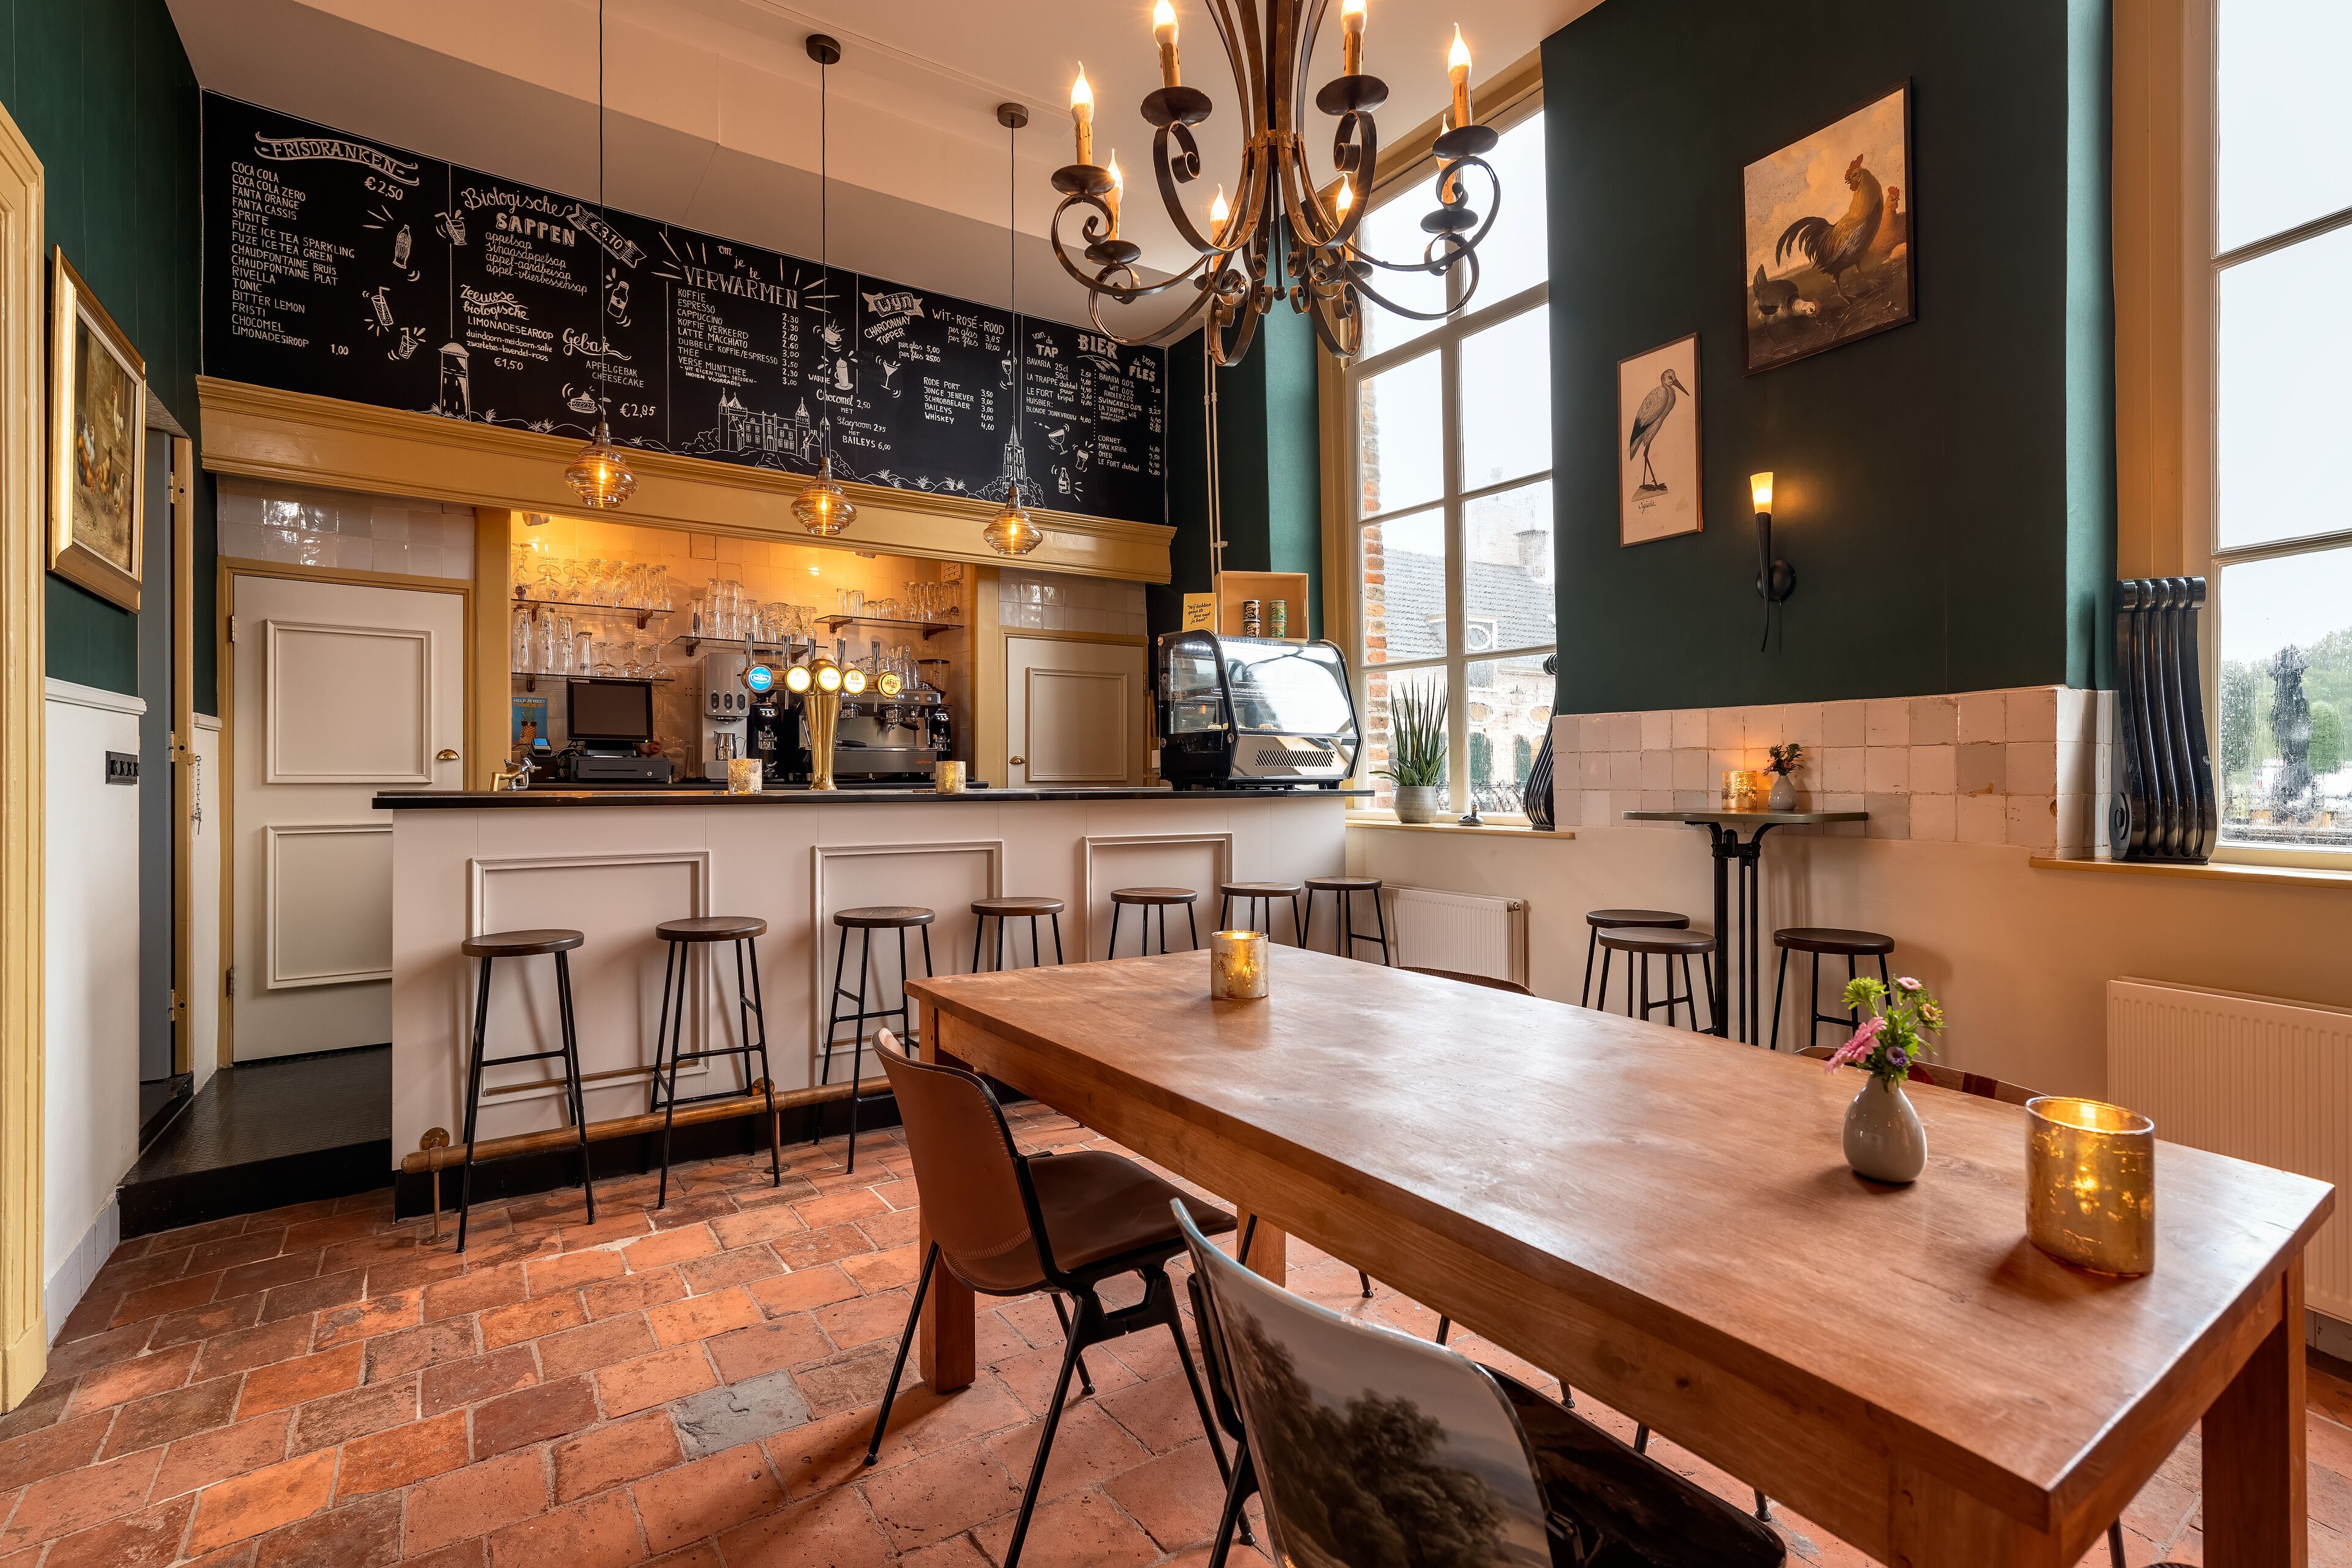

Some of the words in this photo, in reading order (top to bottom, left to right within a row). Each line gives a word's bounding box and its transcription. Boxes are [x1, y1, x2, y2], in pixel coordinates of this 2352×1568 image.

[271, 141, 397, 173] FRISDRANKEN
[232, 162, 254, 176] COCA
[257, 169, 279, 183] COLA
[232, 174, 254, 187] COCA
[257, 181, 279, 195] COLA
[282, 187, 306, 201] ZERO
[232, 185, 260, 200] FANTA
[265, 192, 300, 209] ORANGE
[461, 186, 573, 216] Biologische
[232, 197, 262, 212] FANTA
[265, 205, 296, 220] CASSIS
[232, 208, 269, 225] SPRITE
[496, 213, 575, 246] SAPPEN
[232, 220, 257, 234] FUZE
[262, 227, 276, 238] ICE
[279, 232, 298, 244] TEA
[303, 238, 355, 258] SPARKLING
[232, 232, 258, 245] FUZE
[262, 239, 277, 250] ICE
[279, 243, 298, 255] TEA
[303, 249, 333, 262] GREEN
[486, 232, 532, 249] appelsap
[232, 244, 308, 269] CHAUDFONTAINE
[486, 243, 566, 268] sinaasappelsap
[718, 245, 732, 255] om
[232, 255, 309, 280] CHAUDFONTAINE
[315, 274, 337, 285] PLAT
[486, 254, 571, 281] appel-aardbeisap
[734, 256, 745, 268] je
[233, 267, 276, 284] RIVELLA
[749, 267, 760, 279] te
[232, 278, 262, 292] TONIC
[684, 265, 797, 309] VERWARMEN
[233, 290, 270, 306] BITTER
[275, 300, 304, 313] LEMON
[460, 284, 519, 303] Zeeuwse
[678, 288, 706, 302] KOFFIE
[233, 303, 265, 317] FRISTI
[464, 302, 529, 320] biologische
[678, 299, 715, 314] ESPRESSO
[232, 314, 284, 333] CHOCOMEL
[677, 309, 722, 325] CAPPUCCINO
[678, 318, 704, 330] KOFFIE
[708, 325, 748, 339] VERKEERD
[864, 316, 910, 338] CHARDONNAY
[961, 328, 978, 339] glas
[233, 325, 309, 347] LIMONADESIROOP
[563, 328, 610, 356] Gebak
[678, 327, 703, 339] LATTE
[707, 333, 748, 349] MACCHIATO
[876, 328, 905, 345] TOPPER
[963, 337, 978, 347] fles
[677, 347, 699, 357] THEE
[679, 338, 713, 351] DUBBELE
[910, 341, 922, 352] glas
[1036, 344, 1058, 358] TAP
[1078, 334, 1117, 359] BIER
[678, 356, 703, 368] VERSE
[911, 350, 923, 361] fles
[1142, 356, 1156, 369] van
[494, 358, 523, 371] €1,50
[586, 360, 638, 377] APPELGEBAK
[1027, 357, 1050, 369] BAVARIA
[1055, 363, 1068, 372] 25cl
[592, 372, 644, 388] CHEESECAKE
[1035, 374, 1058, 386] TRAPPE
[1060, 380, 1077, 390] dubbel
[1055, 372, 1068, 380] 50cl
[1099, 373, 1119, 384] BAVARIA
[1129, 366, 1155, 382] FLES
[924, 377, 940, 386] RODE
[944, 382, 960, 390] PORT
[816, 389, 854, 406] Chocomel
[924, 386, 944, 396] JONGE
[948, 391, 974, 402] JENEVER
[1036, 388, 1053, 398] FORT
[1057, 394, 1074, 404] tripel
[1104, 390, 1122, 399] RADLER
[620, 403, 655, 417] €2,85
[925, 395, 970, 410] SCHROBBELAER
[925, 403, 952, 414] BAILEYS
[1107, 406, 1125, 415] TRAPPE
[925, 412, 954, 424] WHISKEY
[1027, 406, 1046, 415] BLONDE
[1047, 410, 1076, 420] JONKVROUW
[837, 417, 872, 430] Slagroom
[843, 435, 875, 448] BAILEYS
[1098, 435, 1121, 444] CORNET
